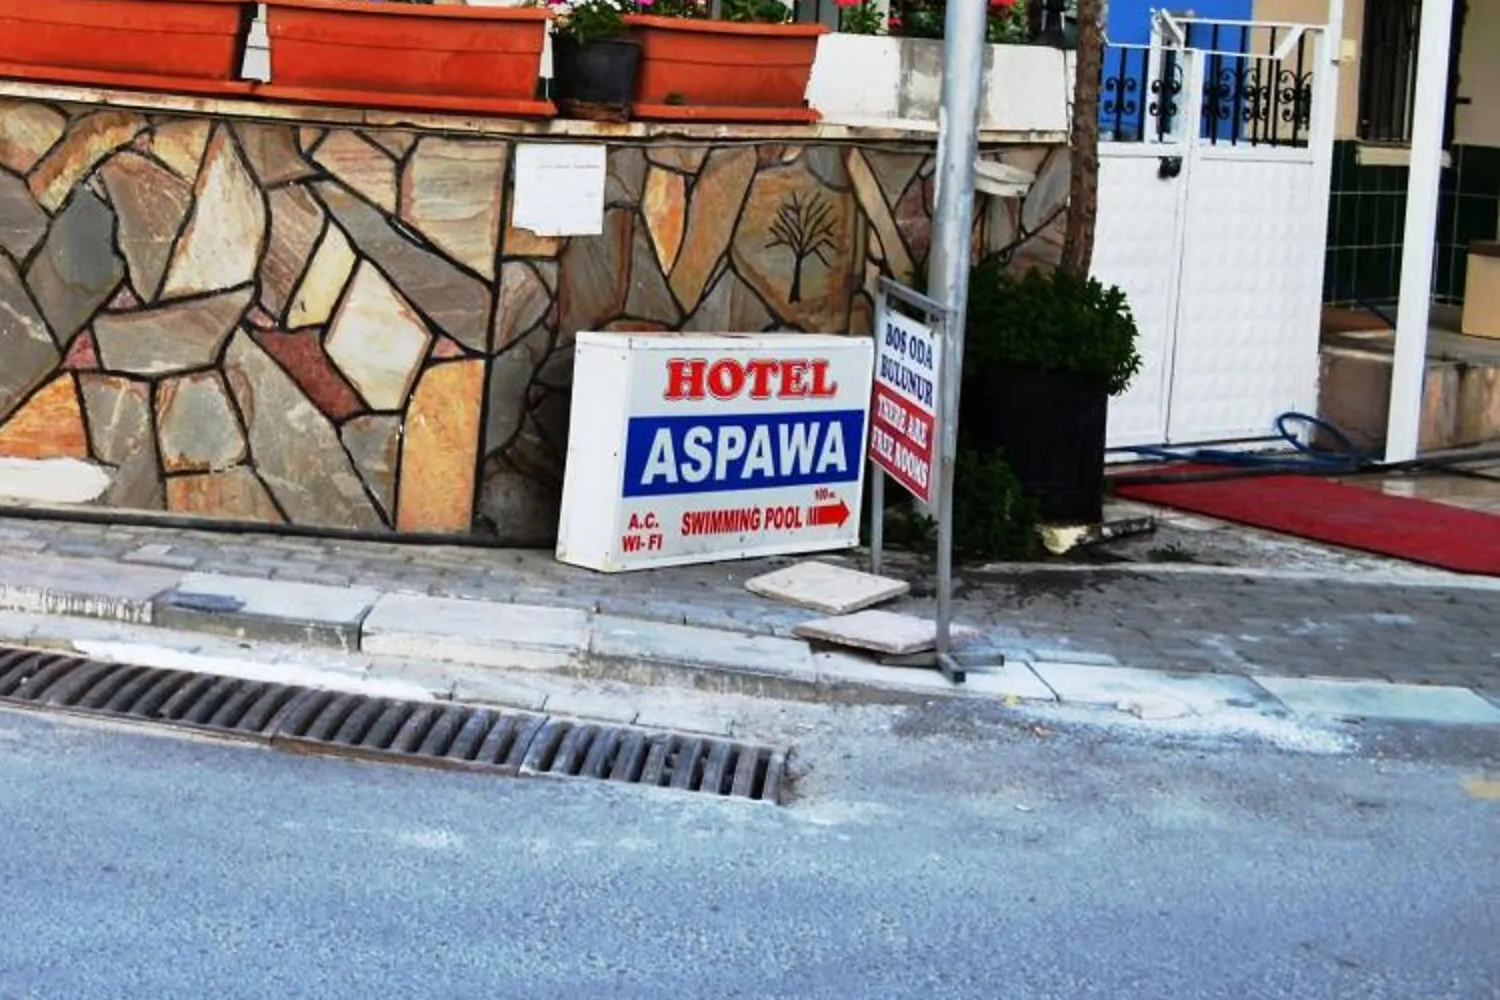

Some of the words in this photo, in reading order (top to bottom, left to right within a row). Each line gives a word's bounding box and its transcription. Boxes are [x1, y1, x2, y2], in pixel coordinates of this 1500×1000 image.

[909, 336, 933, 370] ODA
[663, 357, 838, 401] HOTEL
[881, 354, 933, 408] BULUNUR
[640, 420, 847, 486] ASPAWA
[871, 425, 895, 462] FREE
[894, 441, 929, 490] ROOMS
[628, 513, 660, 530] A.C.
[681, 506, 761, 536] SWIMMING
[764, 505, 803, 530] POOL
